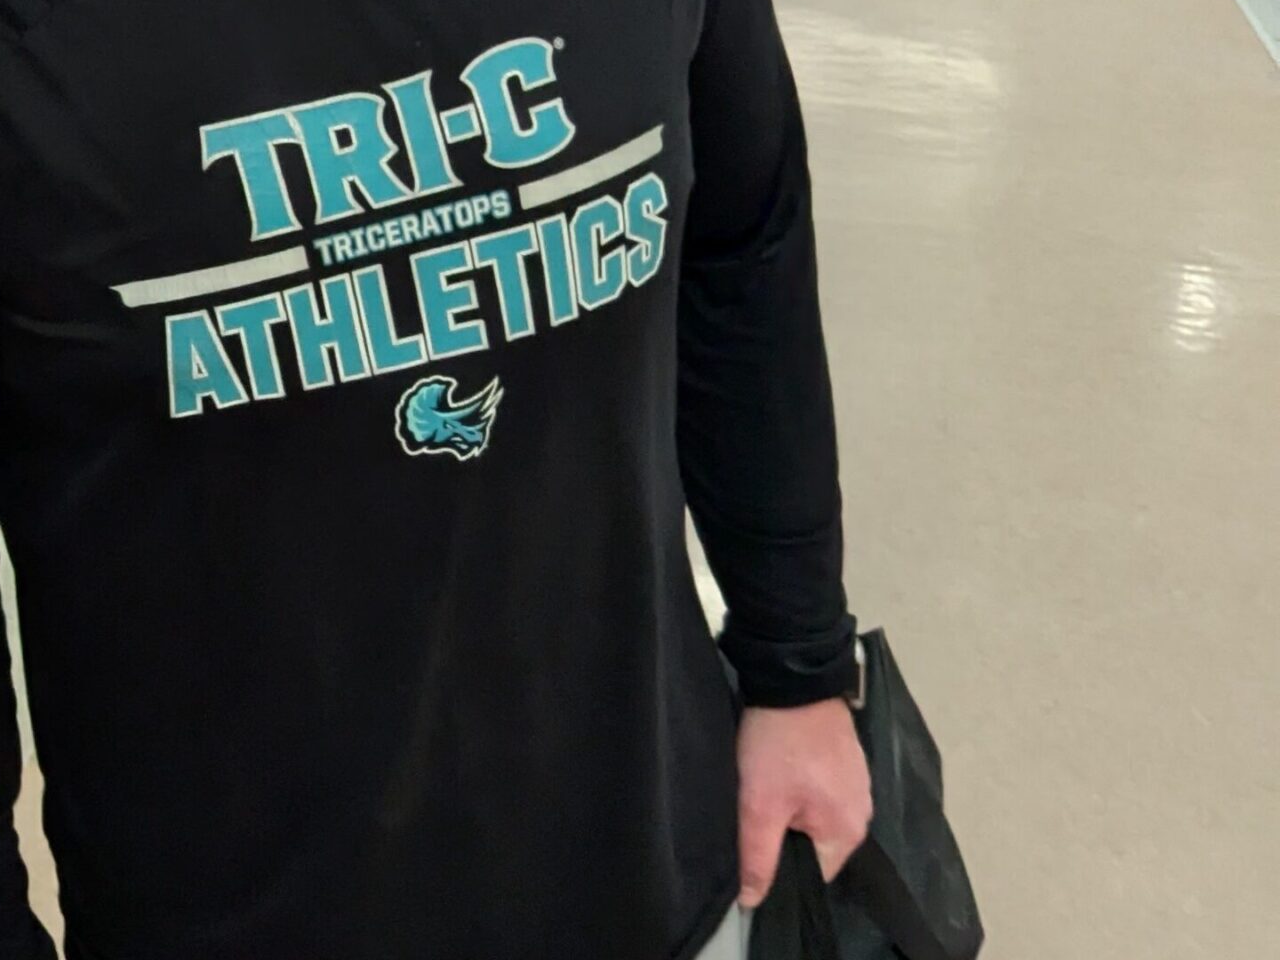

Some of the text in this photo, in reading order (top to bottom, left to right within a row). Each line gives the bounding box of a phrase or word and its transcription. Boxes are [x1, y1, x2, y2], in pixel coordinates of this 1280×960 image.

[200, 36, 575, 241] TRI-C
[313, 189, 512, 267] TRICERATOPS
[164, 172, 669, 419] ATHLETICS
